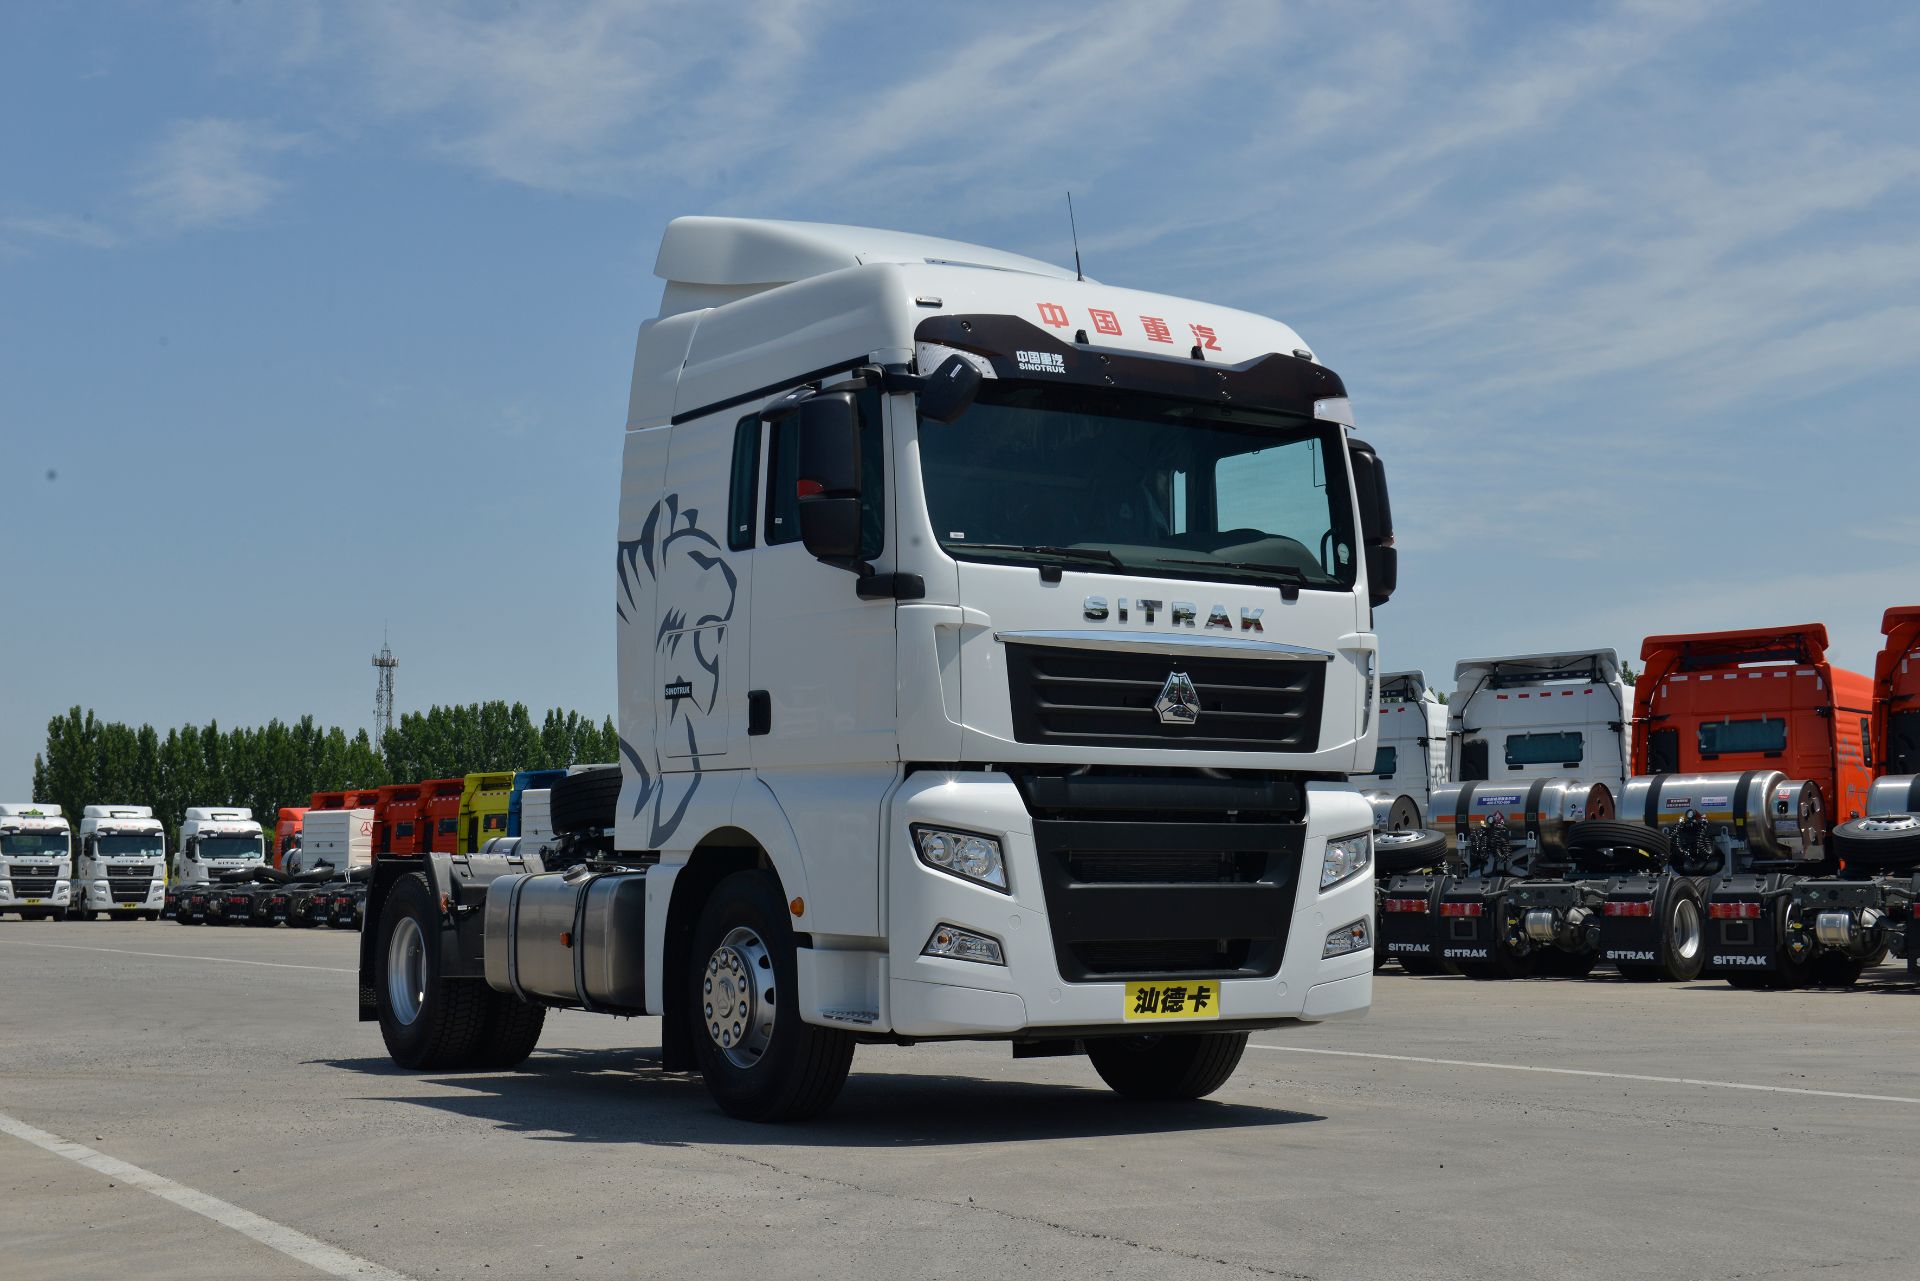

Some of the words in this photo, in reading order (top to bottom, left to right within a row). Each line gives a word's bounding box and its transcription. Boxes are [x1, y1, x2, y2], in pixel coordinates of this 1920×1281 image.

[1036, 302, 1222, 351] 中国重汽
[1016, 350, 1064, 367] 中国重汽
[1019, 362, 1066, 373] SINOTRUK
[1083, 594, 1264, 632] SITRAK
[1388, 943, 1430, 952] SITRAK
[1443, 949, 1487, 958] SITRAK
[1606, 950, 1655, 960] SITRAK
[1712, 955, 1767, 966] SITRAK
[1133, 985, 1211, 1014] 汕德卡
